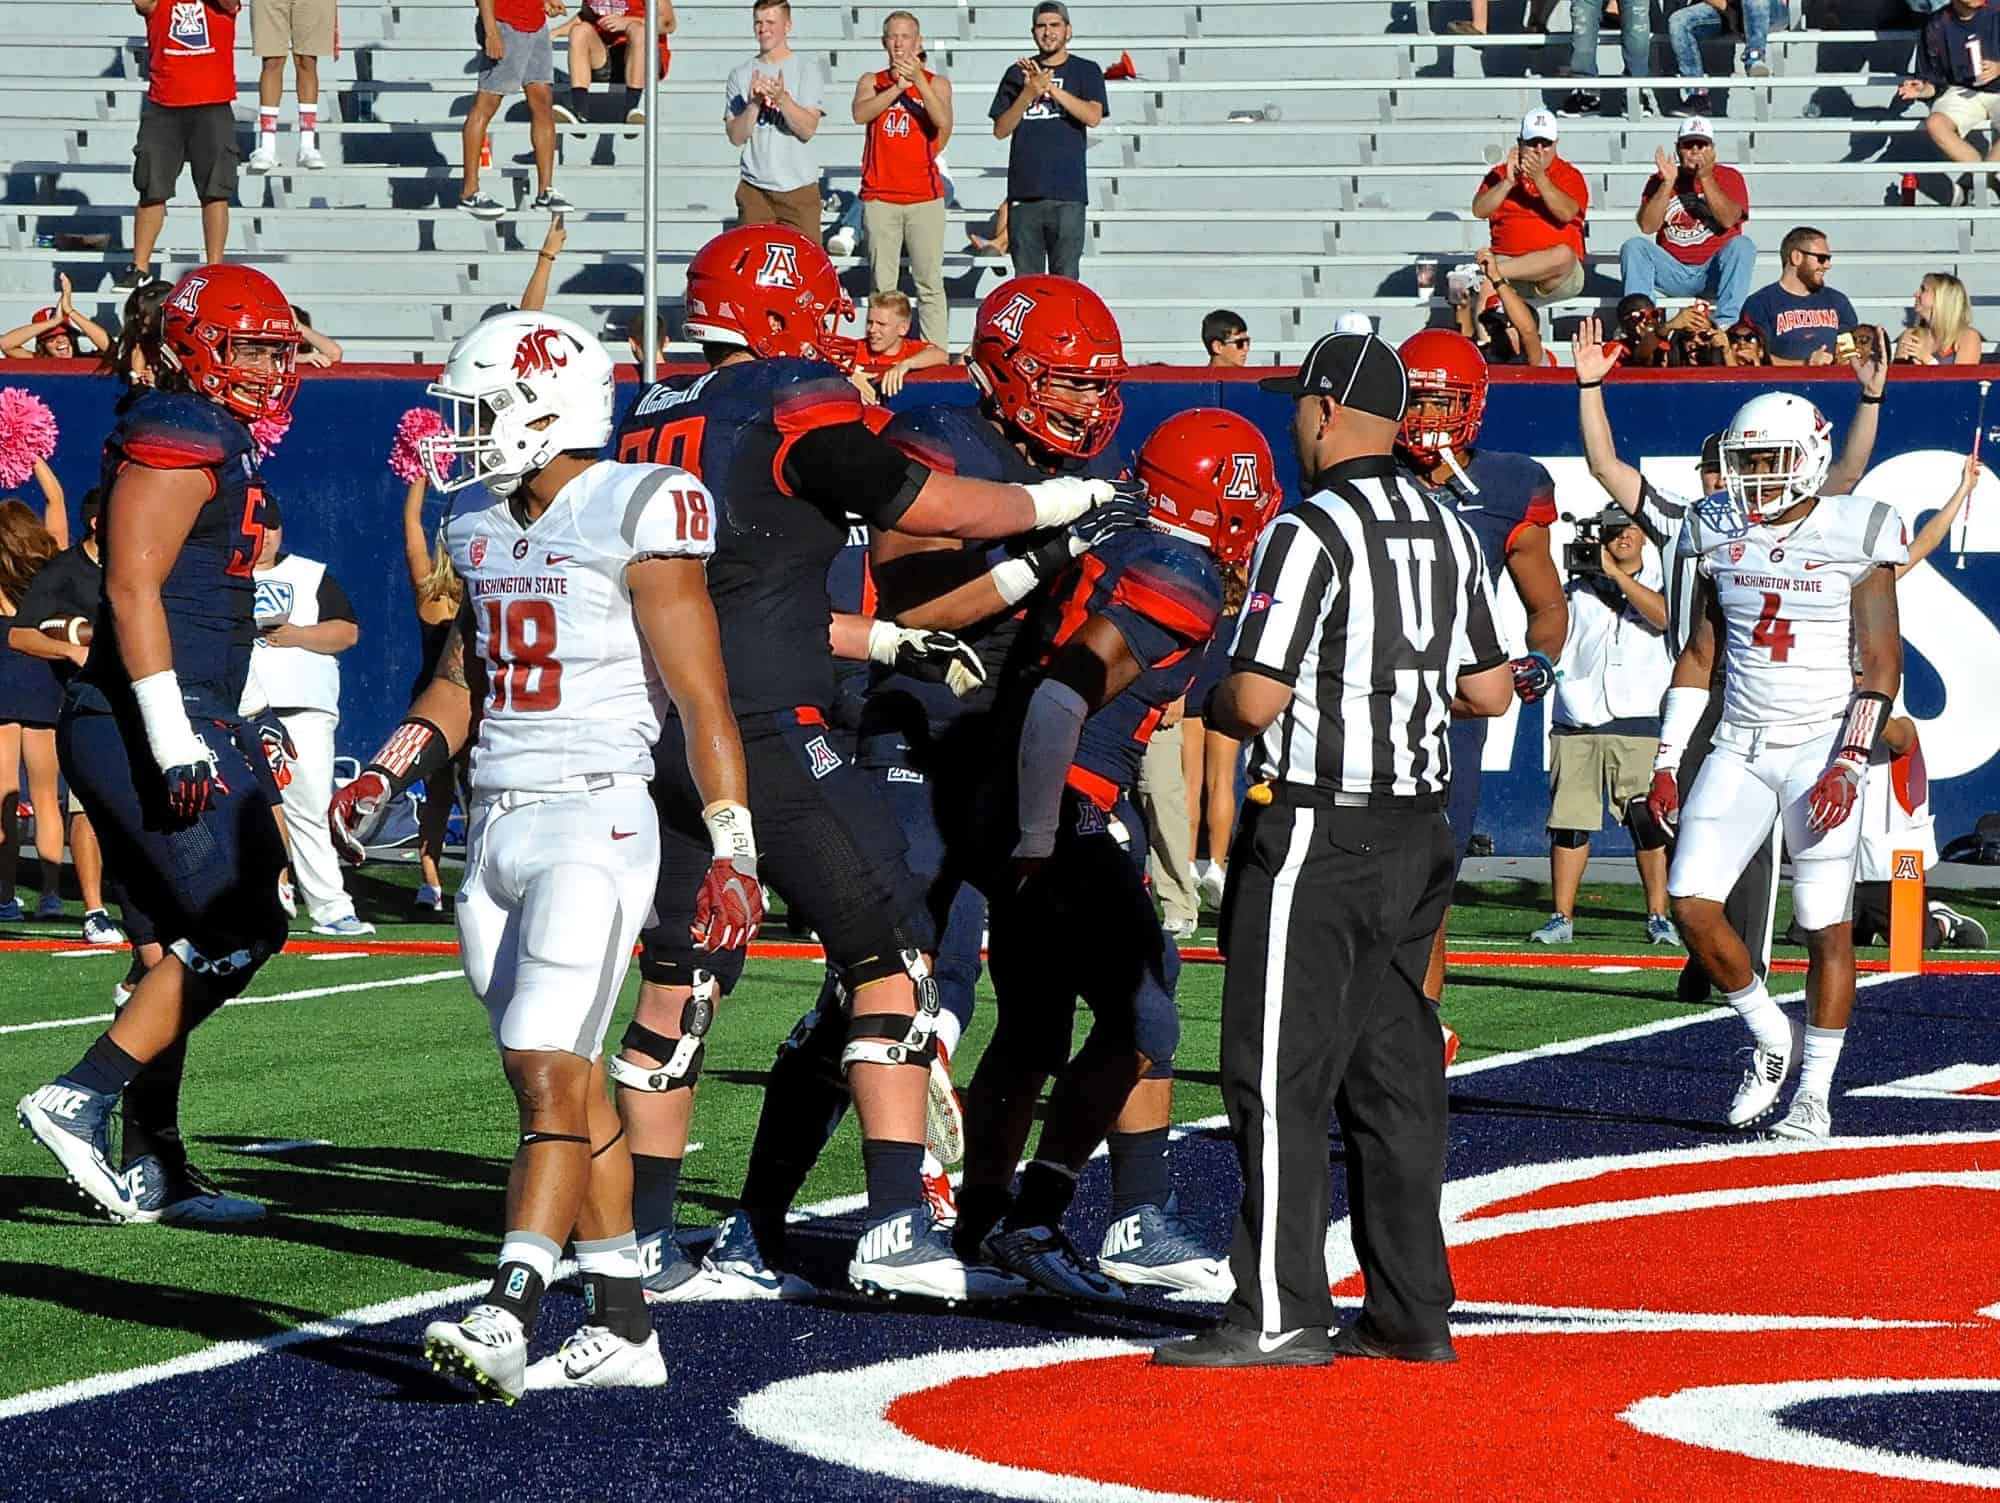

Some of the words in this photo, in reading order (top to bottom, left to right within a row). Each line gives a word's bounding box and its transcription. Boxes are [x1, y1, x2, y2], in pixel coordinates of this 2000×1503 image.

[883, 112, 910, 138] 44
[755, 242, 803, 289] A
[175, 276, 209, 318] A
[989, 292, 1036, 343] A
[1776, 308, 1839, 336] ARIZONA
[1223, 453, 1259, 500] A
[668, 490, 709, 541] 18
[475, 576, 532, 596] WASHINGTON
[535, 576, 568, 595] STATE
[1733, 573, 1790, 590] WASHINGTON
[1792, 579, 1823, 593] STATE
[1751, 591, 1796, 662] 4
[482, 599, 563, 713] 18
[805, 735, 843, 779] A
[1895, 855, 1919, 880] A
[1765, 1051, 1784, 1083] NIKE
[30, 1084, 91, 1120] NIKE
[118, 1165, 147, 1197] KE
[856, 1214, 913, 1264] NIKE
[1101, 1213, 1143, 1259] NIKE
[640, 1238, 662, 1279] KE
